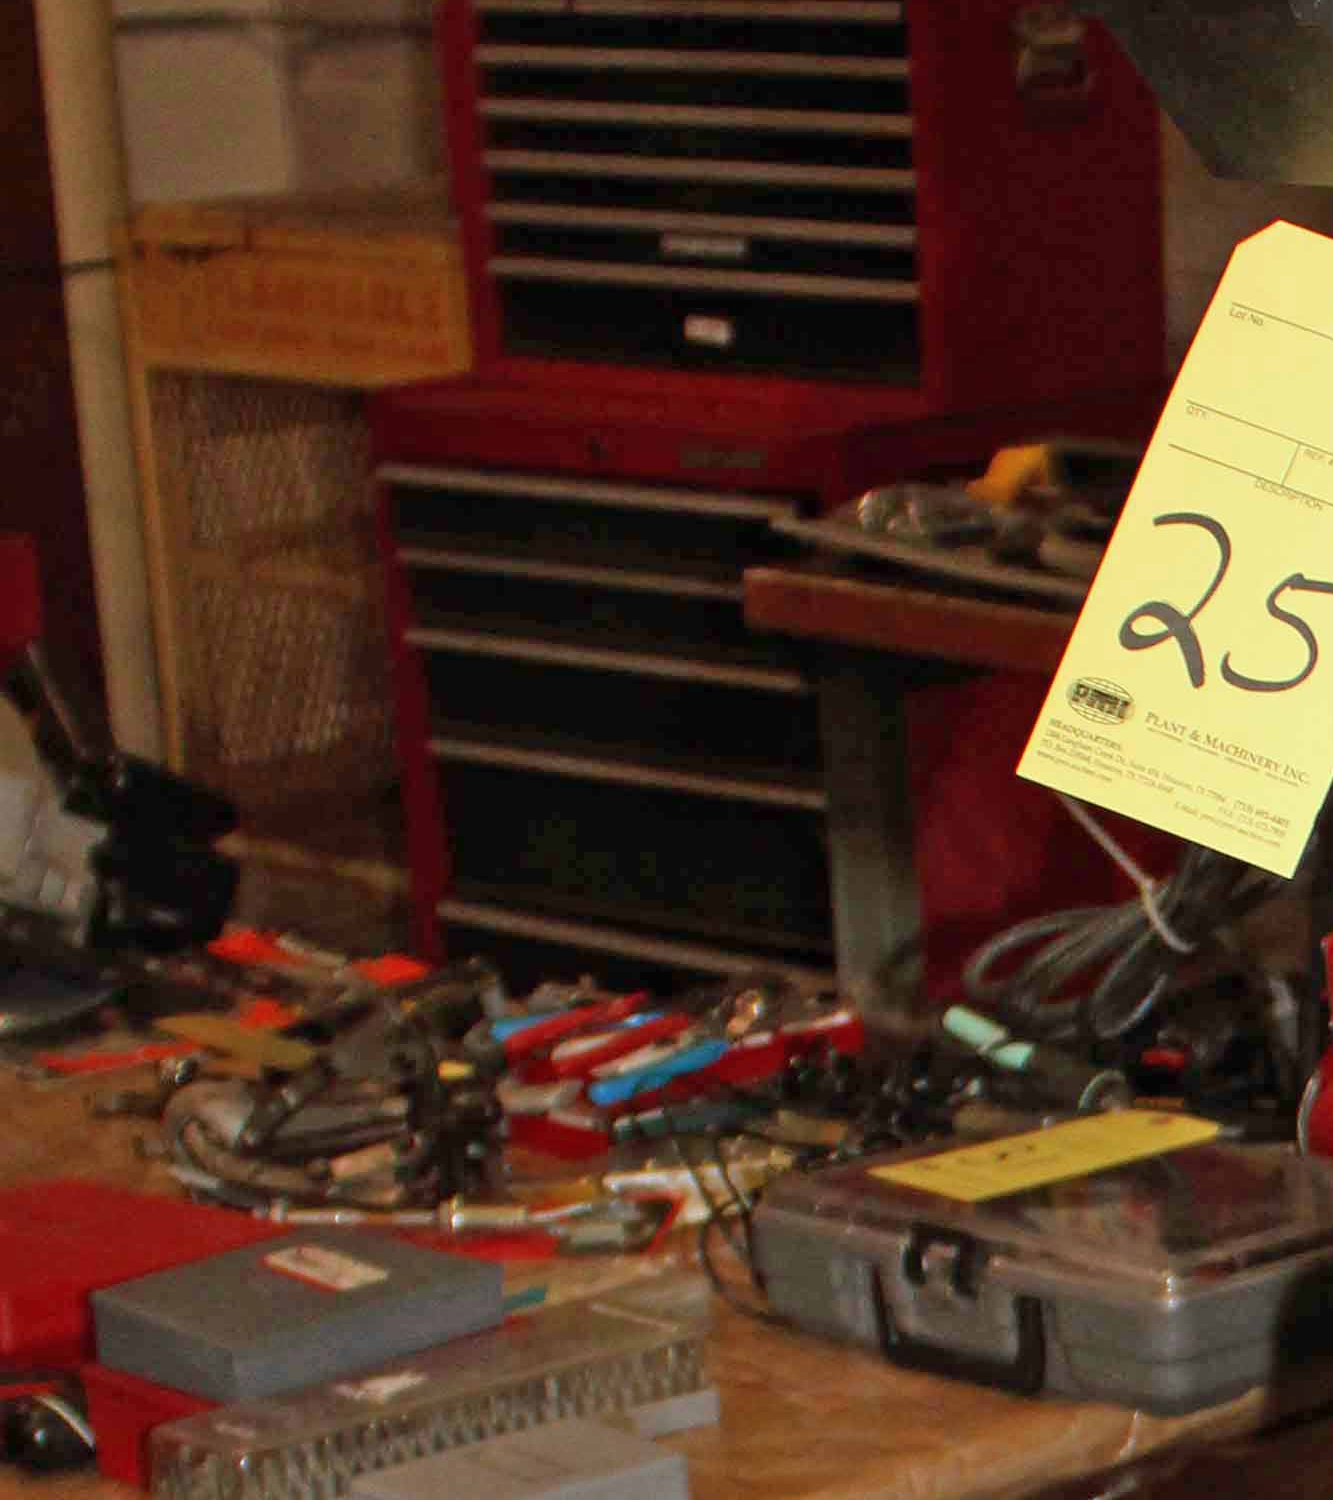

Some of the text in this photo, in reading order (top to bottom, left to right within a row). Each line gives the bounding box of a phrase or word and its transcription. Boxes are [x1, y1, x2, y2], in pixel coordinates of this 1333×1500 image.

[1144, 712, 1188, 736] PLANT
[1189, 728, 1201, 743] &
[1201, 732, 1282, 775] MACHINERY
